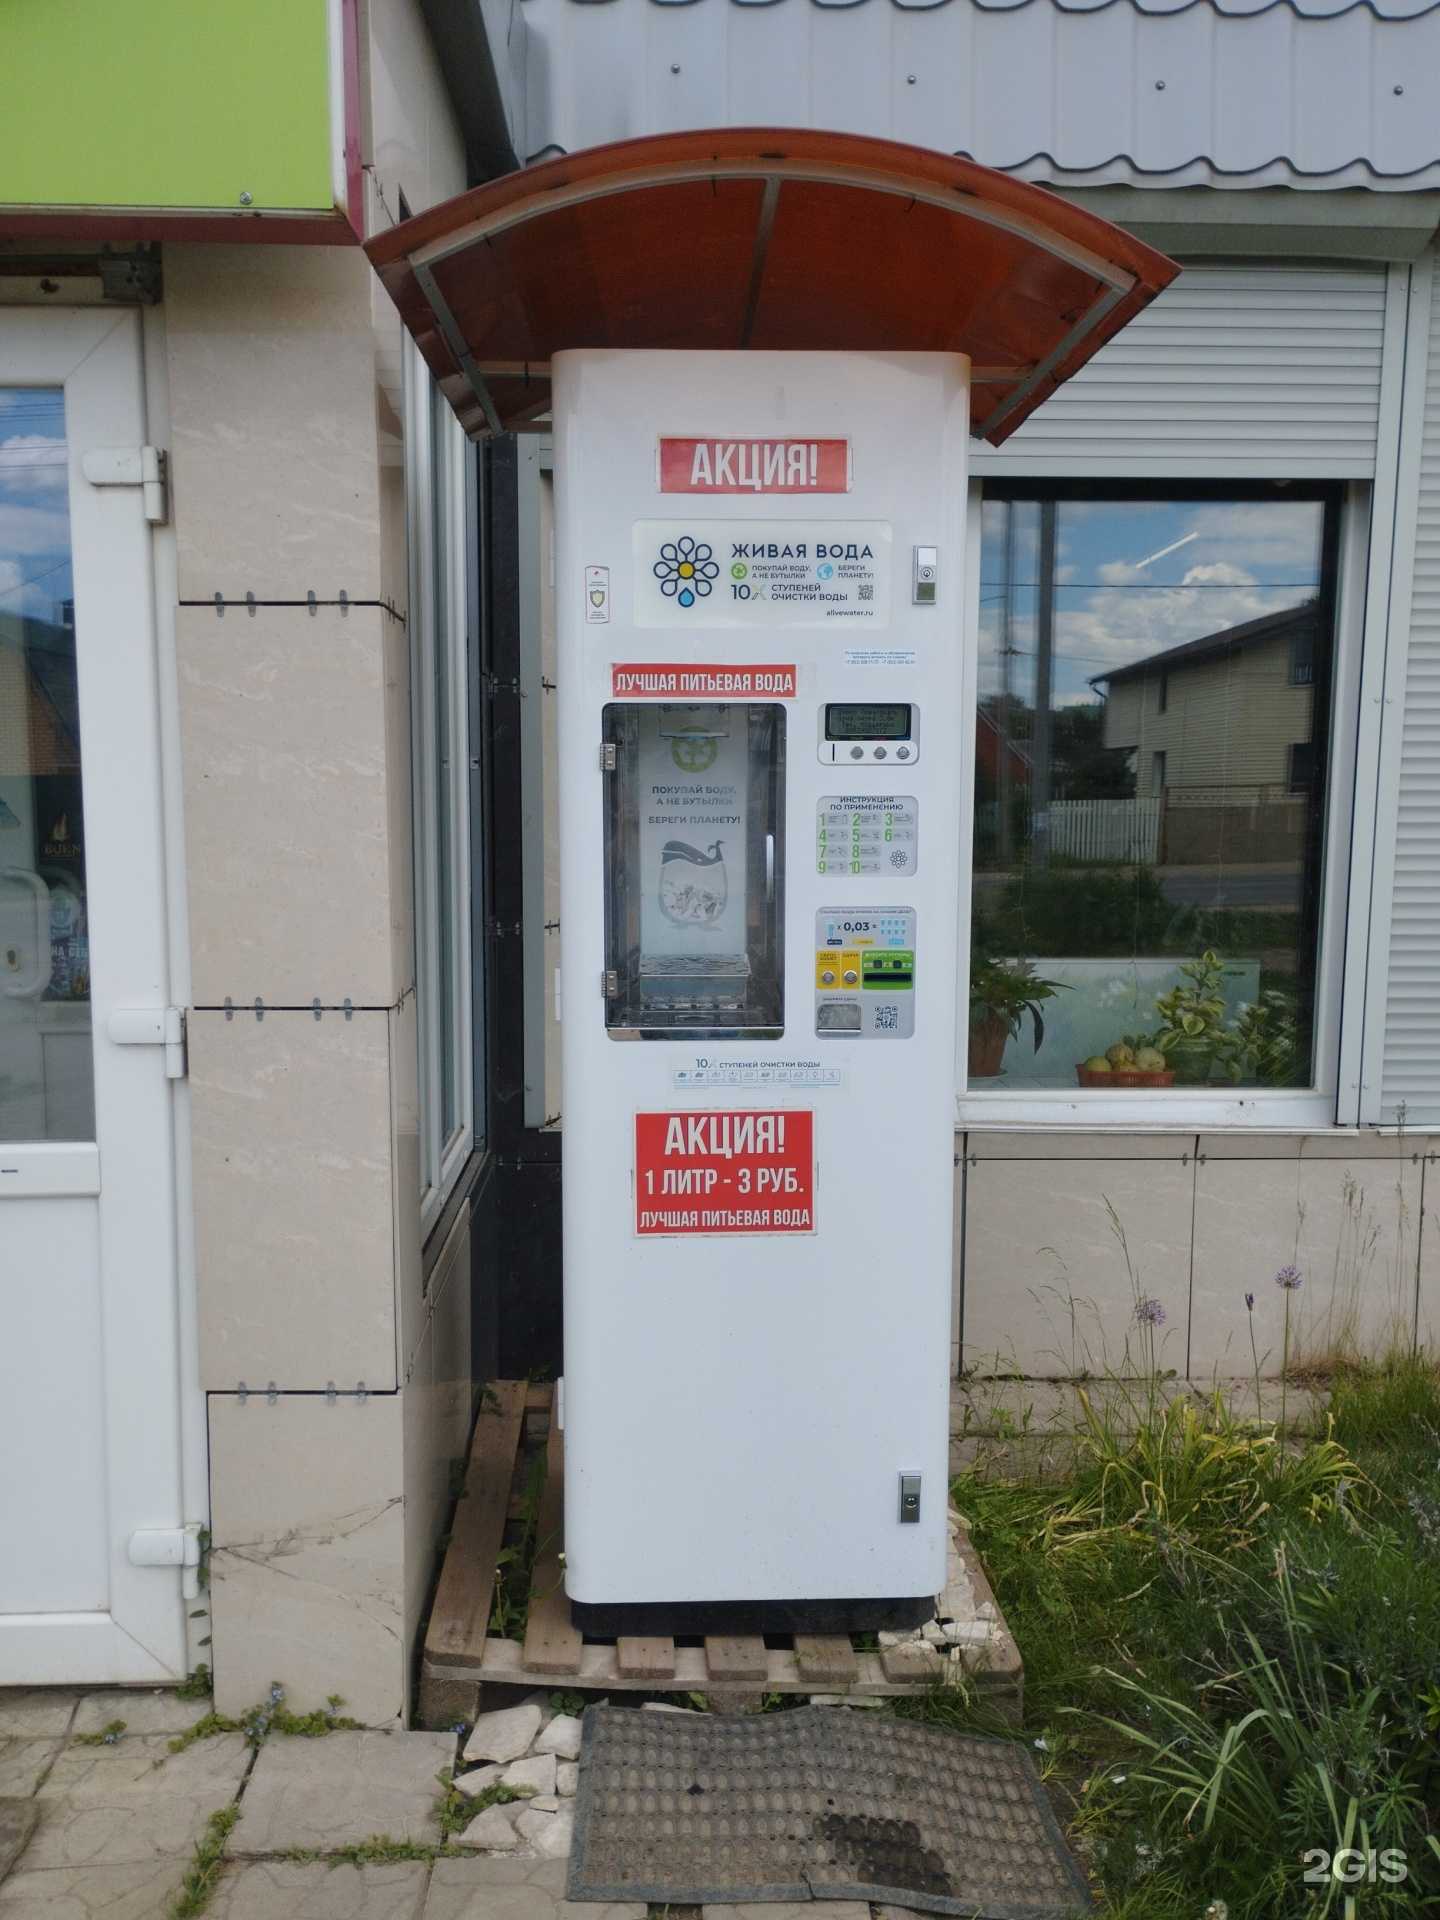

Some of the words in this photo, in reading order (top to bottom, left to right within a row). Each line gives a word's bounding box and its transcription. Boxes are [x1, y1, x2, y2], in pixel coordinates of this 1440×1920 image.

[690, 443, 818, 491] АКЦИЯ!
[731, 543, 807, 559] ЖИВАЯ
[816, 543, 874, 561] ВОДА
[752, 564, 788, 572] ПОКУПАЙ
[837, 564, 866, 572] БЕРЕГИ
[771, 583, 821, 592] СТУПЕНЕЙ
[771, 593, 817, 602] ОЧИСТКИ
[819, 593, 848, 602] ВОДЫ
[826, 608, 875, 617] alivewater.ru
[616, 673, 677, 692] ЛУЧШАЯ
[680, 673, 751, 692] ПИТЬЕВАЯ
[755, 673, 794, 693] ВОДА
[651, 784, 704, 795] ПОКУПАЙ
[656, 797, 664, 806] А
[665, 797, 681, 806] НЕ
[840, 795, 895, 804] ИНСТРУКЦИЯ
[830, 803, 842, 811] ПО
[844, 803, 904, 811] ПРИМЕНЕНИЮ
[648, 815, 688, 825] БЕРЕГИ
[689, 815, 741, 825] ПЛАНЕТУ!
[852, 812, 861, 827] 2
[885, 812, 893, 827] 3
[819, 828, 827, 843] 4
[852, 828, 860, 843] 5
[885, 828, 893, 843] 6
[819, 844, 827, 859] 7
[852, 844, 861, 859] 8
[818, 860, 827, 874] 9
[843, 921, 871, 933] 0,03
[719, 1060, 759, 1069] СТУПЕНЕЙ
[759, 1060, 796, 1069] ОЧИСТКИ
[664, 1115, 786, 1159] АКЦИЯ!
[645, 1169, 654, 1195] 1
[660, 1168, 718, 1195] ЛИТР
[738, 1168, 751, 1194] 3
[757, 1167, 805, 1193] РУБ.
[639, 1210, 698, 1228] ЛУЧШАЯ
[701, 1209, 770, 1227] ПИТЬЕВАЯ
[773, 1208, 811, 1226] ВОДА
